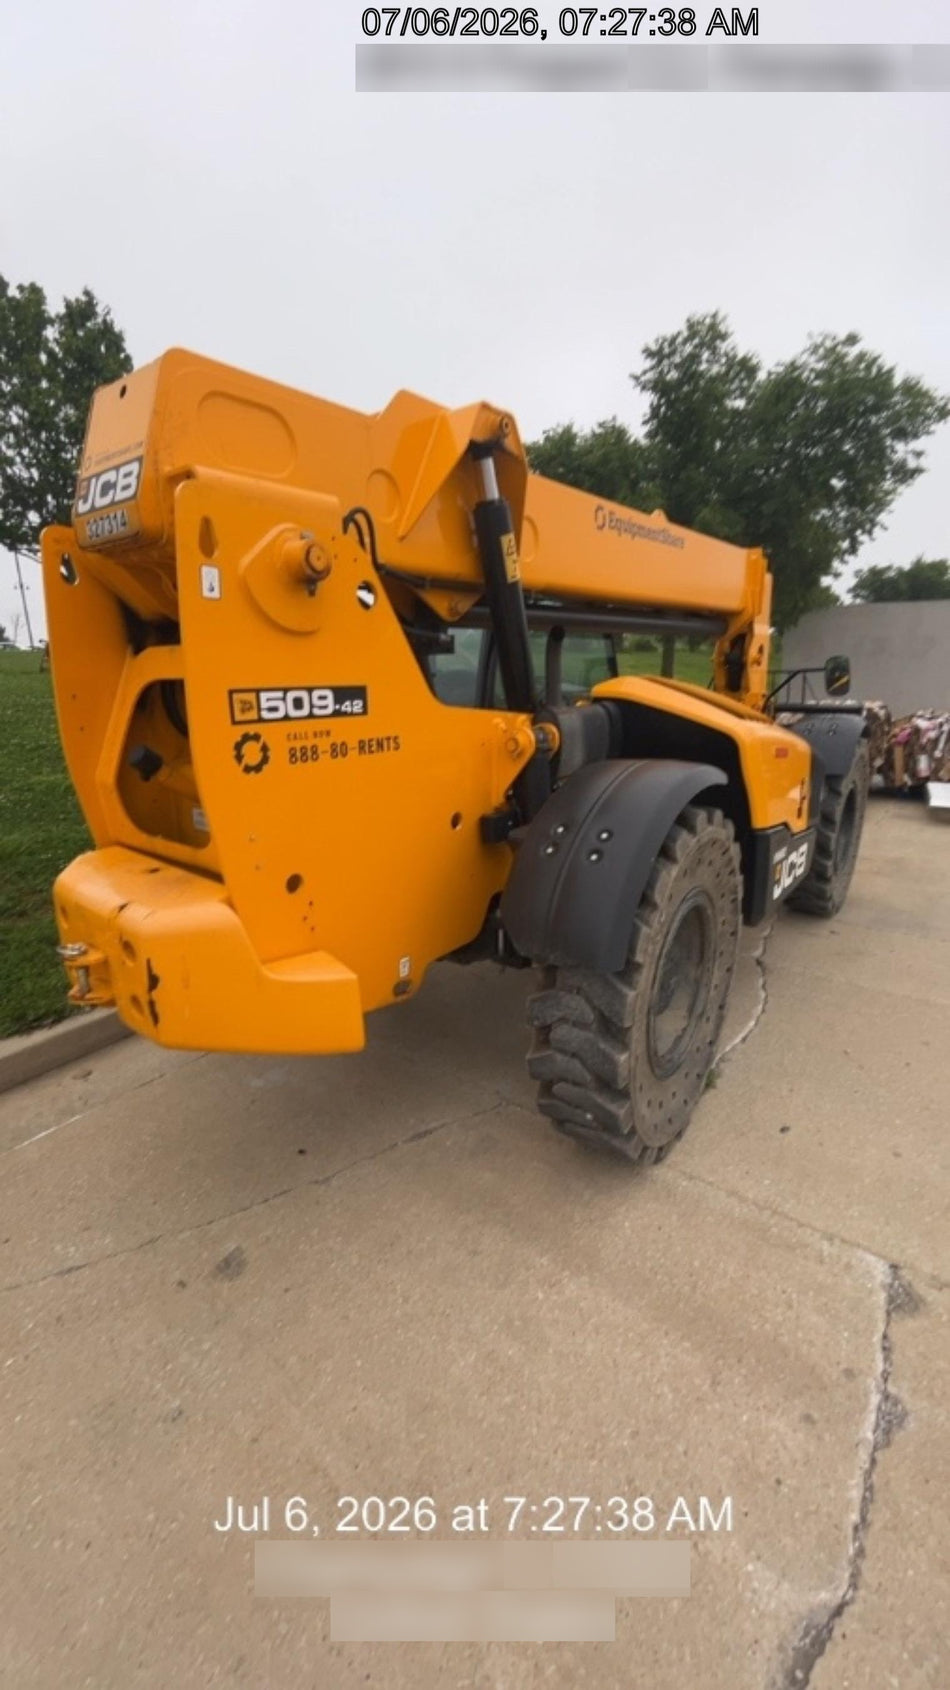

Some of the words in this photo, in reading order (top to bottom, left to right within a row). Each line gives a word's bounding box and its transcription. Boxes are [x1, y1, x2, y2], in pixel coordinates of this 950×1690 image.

[77, 460, 140, 515] JCB
[608, 510, 684, 550] EquipmentShare
[286, 731, 309, 742] CALL
[288, 735, 401, 765] 888-80-RENTS
[773, 842, 808, 900] JCB
